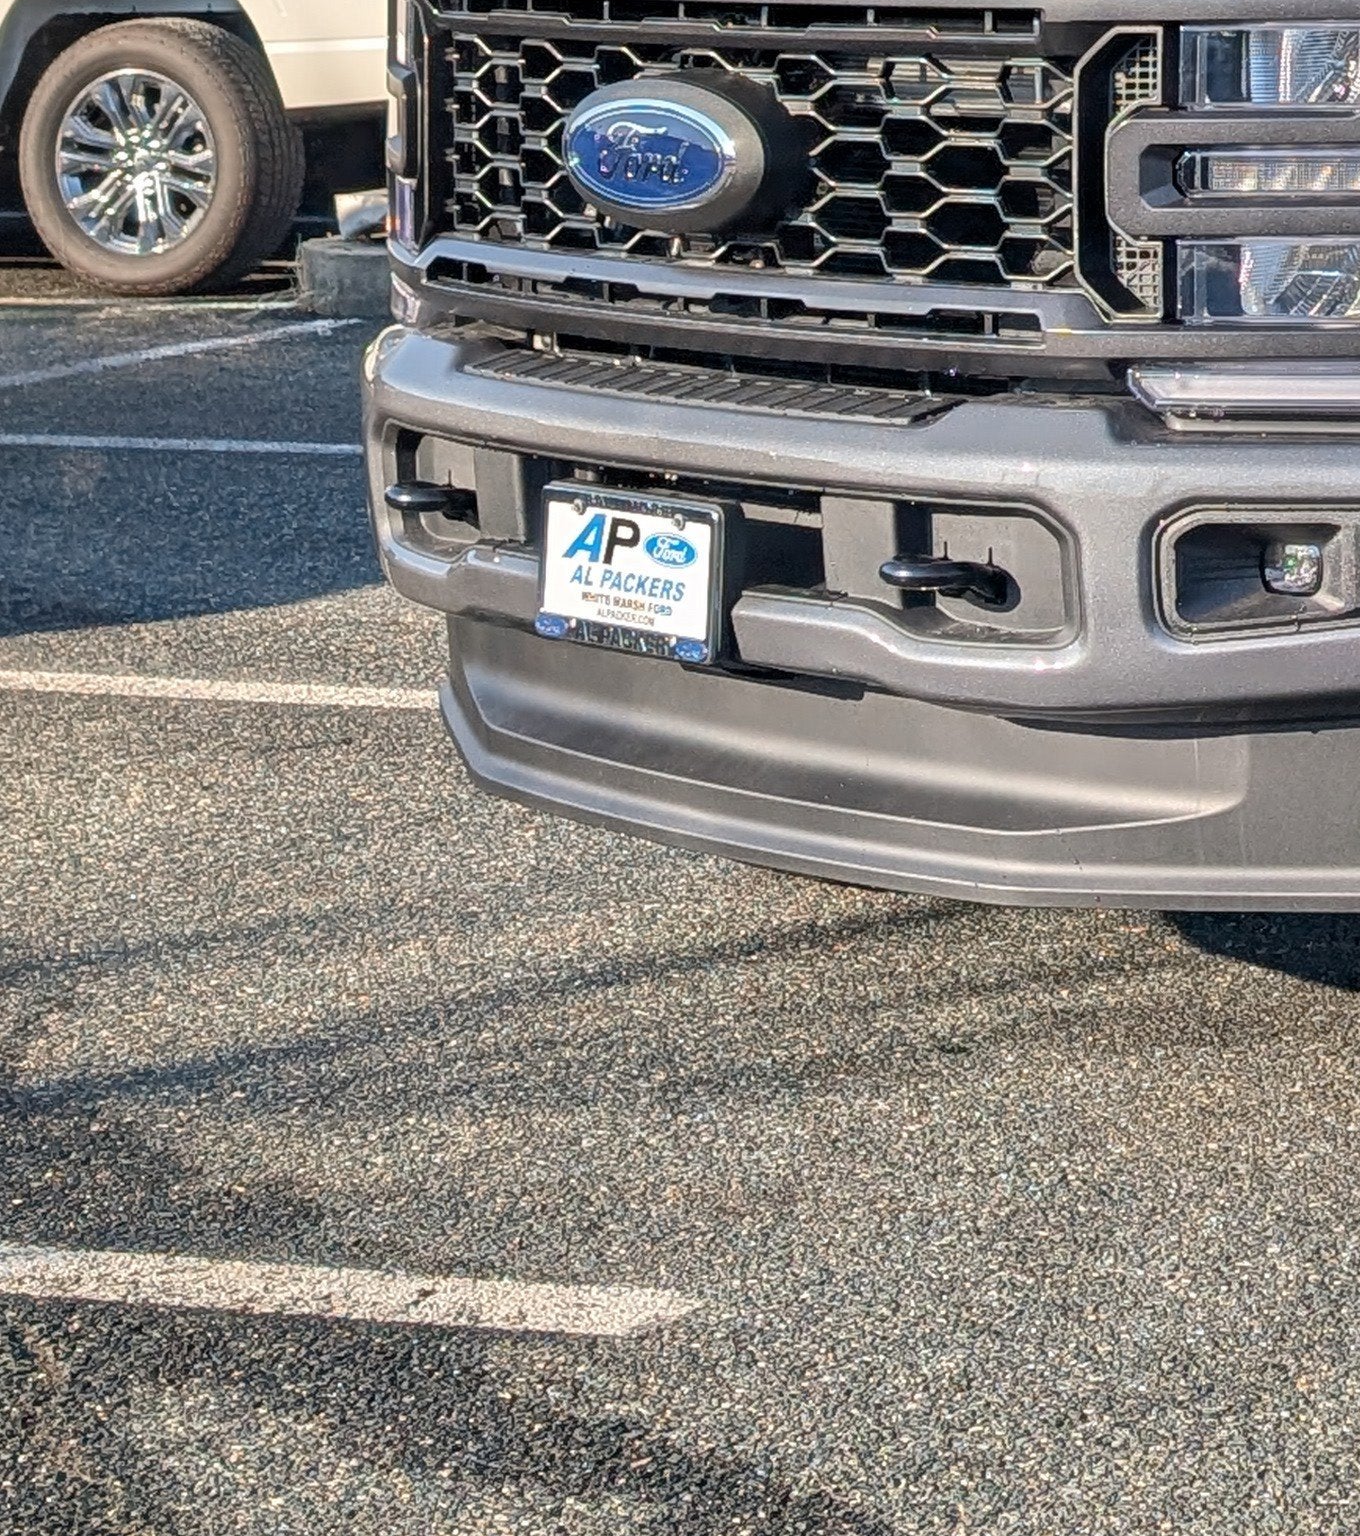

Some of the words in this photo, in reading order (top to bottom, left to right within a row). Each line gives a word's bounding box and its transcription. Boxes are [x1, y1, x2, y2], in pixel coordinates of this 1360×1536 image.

[598, 120, 691, 184] Ford
[561, 513, 640, 565] AP
[652, 534, 688, 565] Ford
[569, 565, 593, 586] AL
[600, 568, 686, 602] PACKERS
